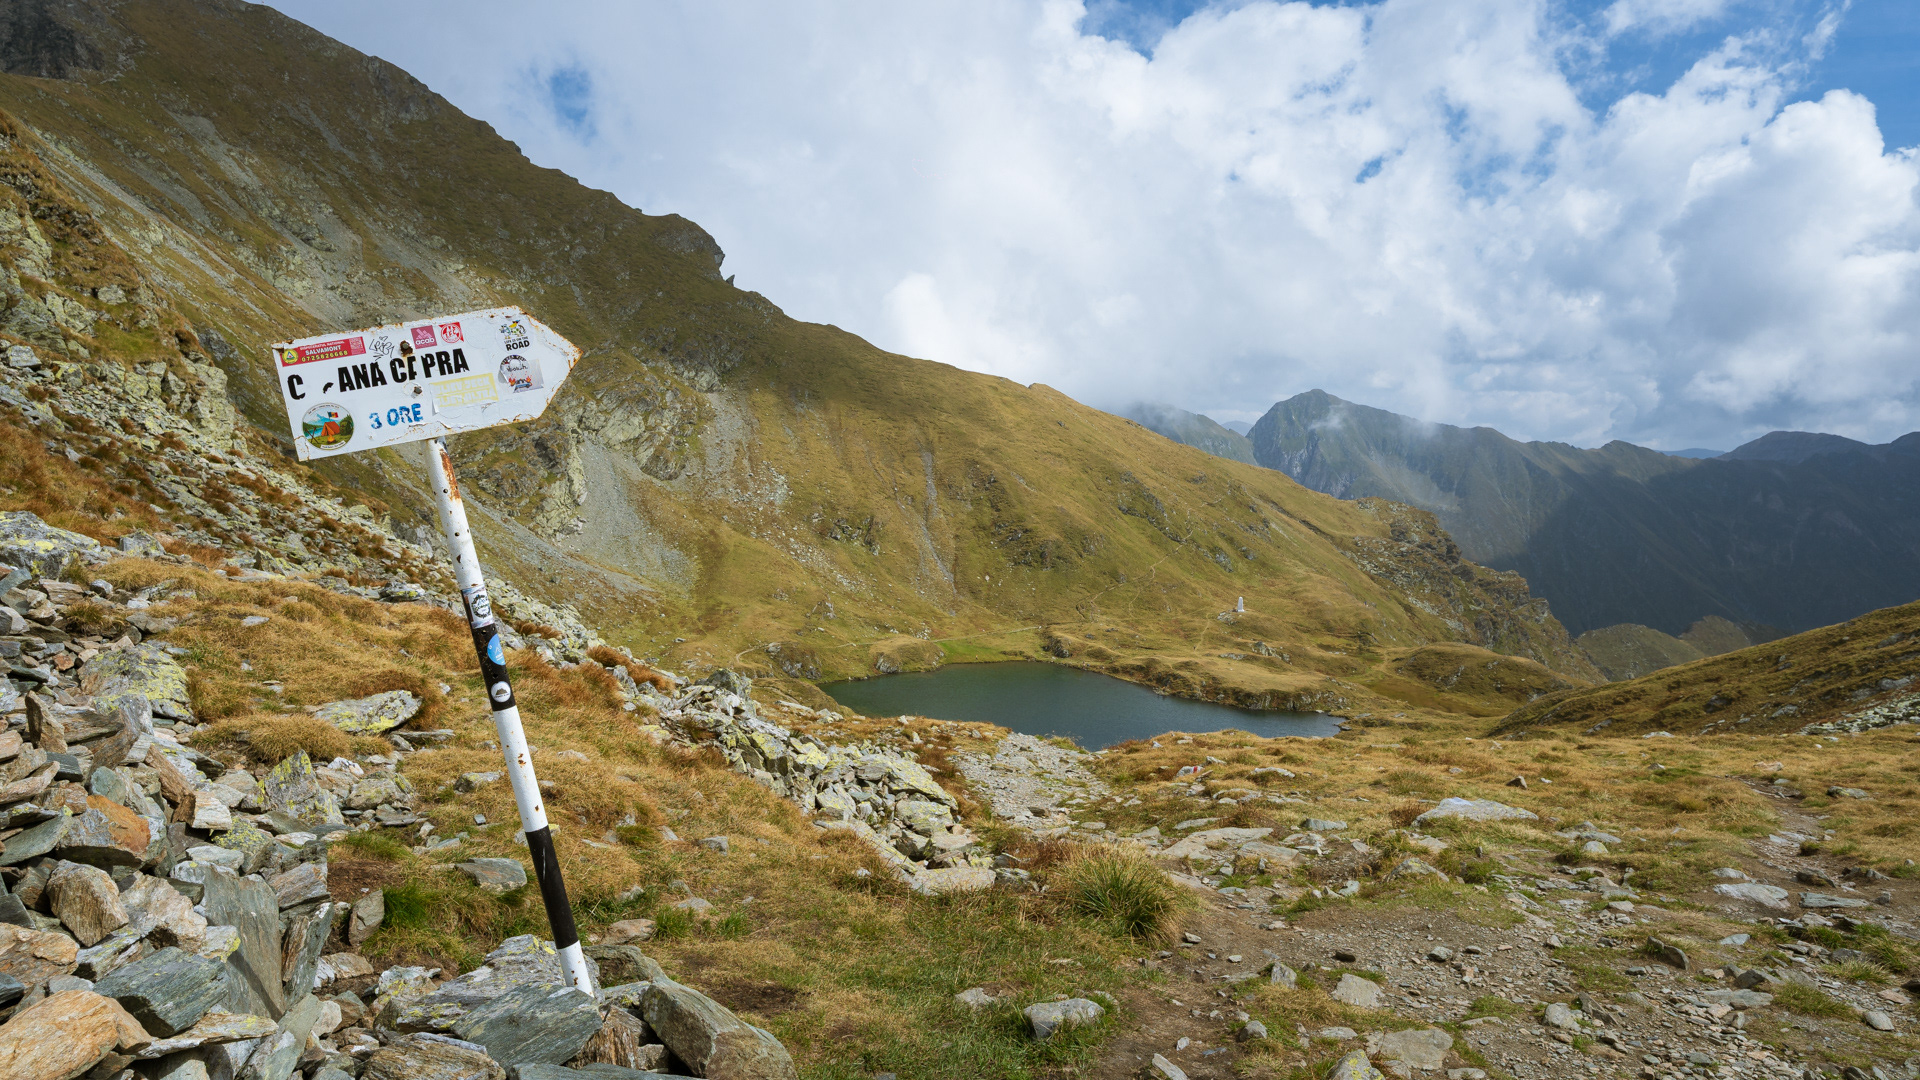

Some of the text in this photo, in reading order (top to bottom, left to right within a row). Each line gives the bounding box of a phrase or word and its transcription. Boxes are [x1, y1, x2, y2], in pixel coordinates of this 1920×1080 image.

[415, 337, 435, 346] acab
[505, 340, 530, 351] ROAD
[305, 345, 341, 356] SALVAMONT
[287, 362, 388, 400] CANA
[369, 403, 424, 430] 3 ORE
